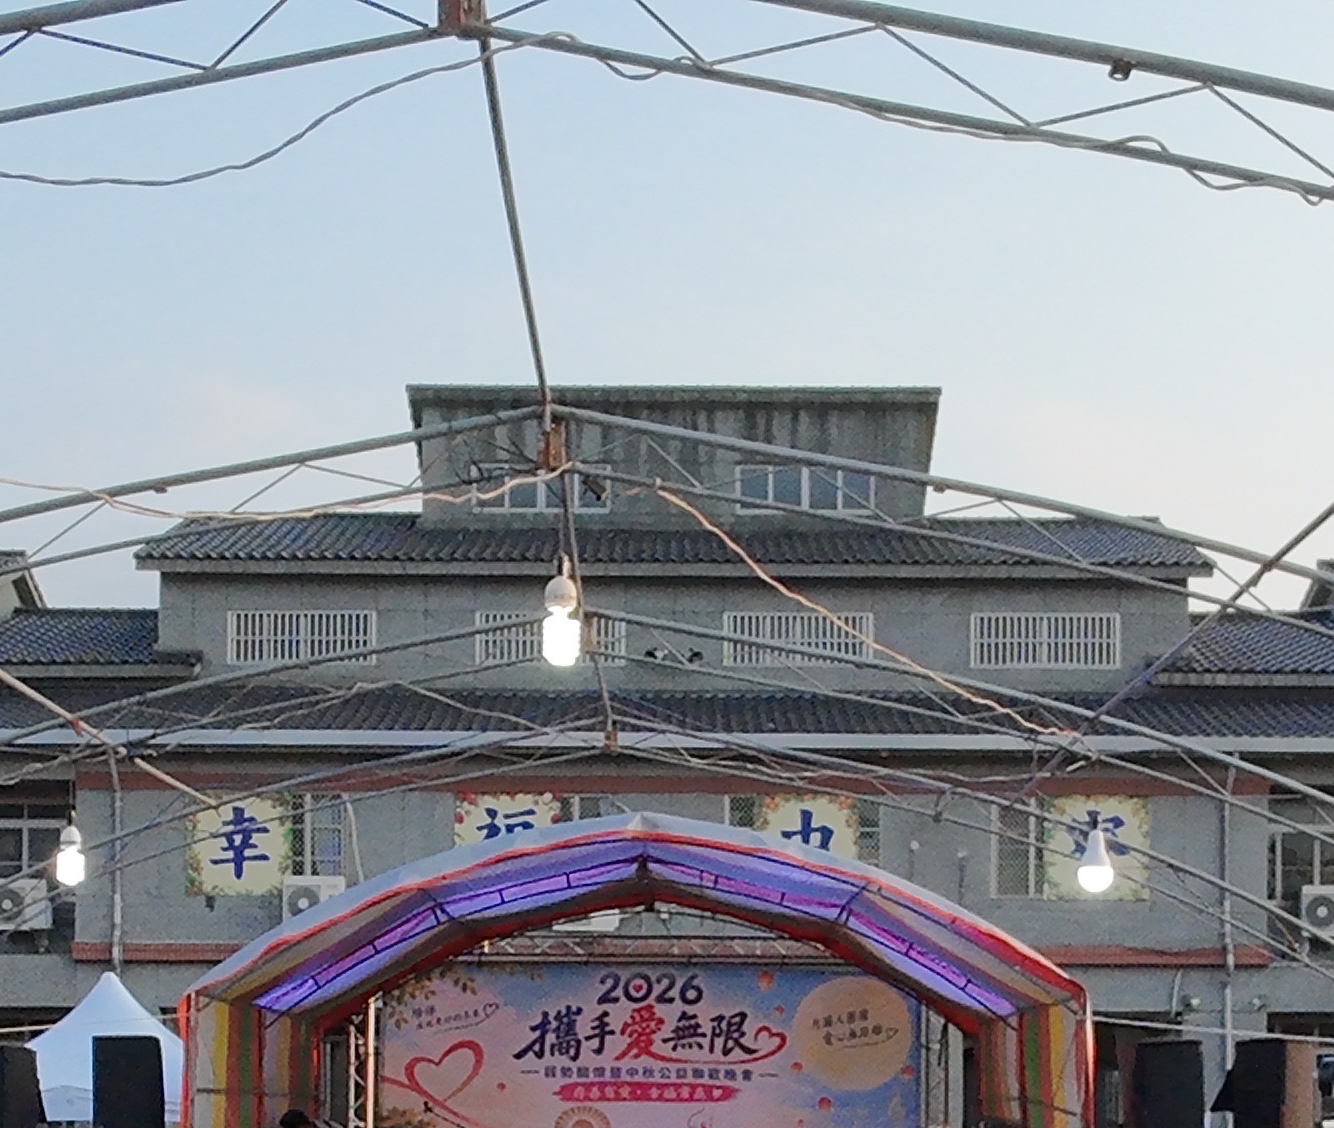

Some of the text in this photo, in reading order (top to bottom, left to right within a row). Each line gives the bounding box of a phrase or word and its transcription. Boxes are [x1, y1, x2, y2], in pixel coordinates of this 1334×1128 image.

[209, 806, 270, 879] 幸
[596, 971, 704, 1005] 2026
[513, 1004, 763, 1062] 攜手愛無限
